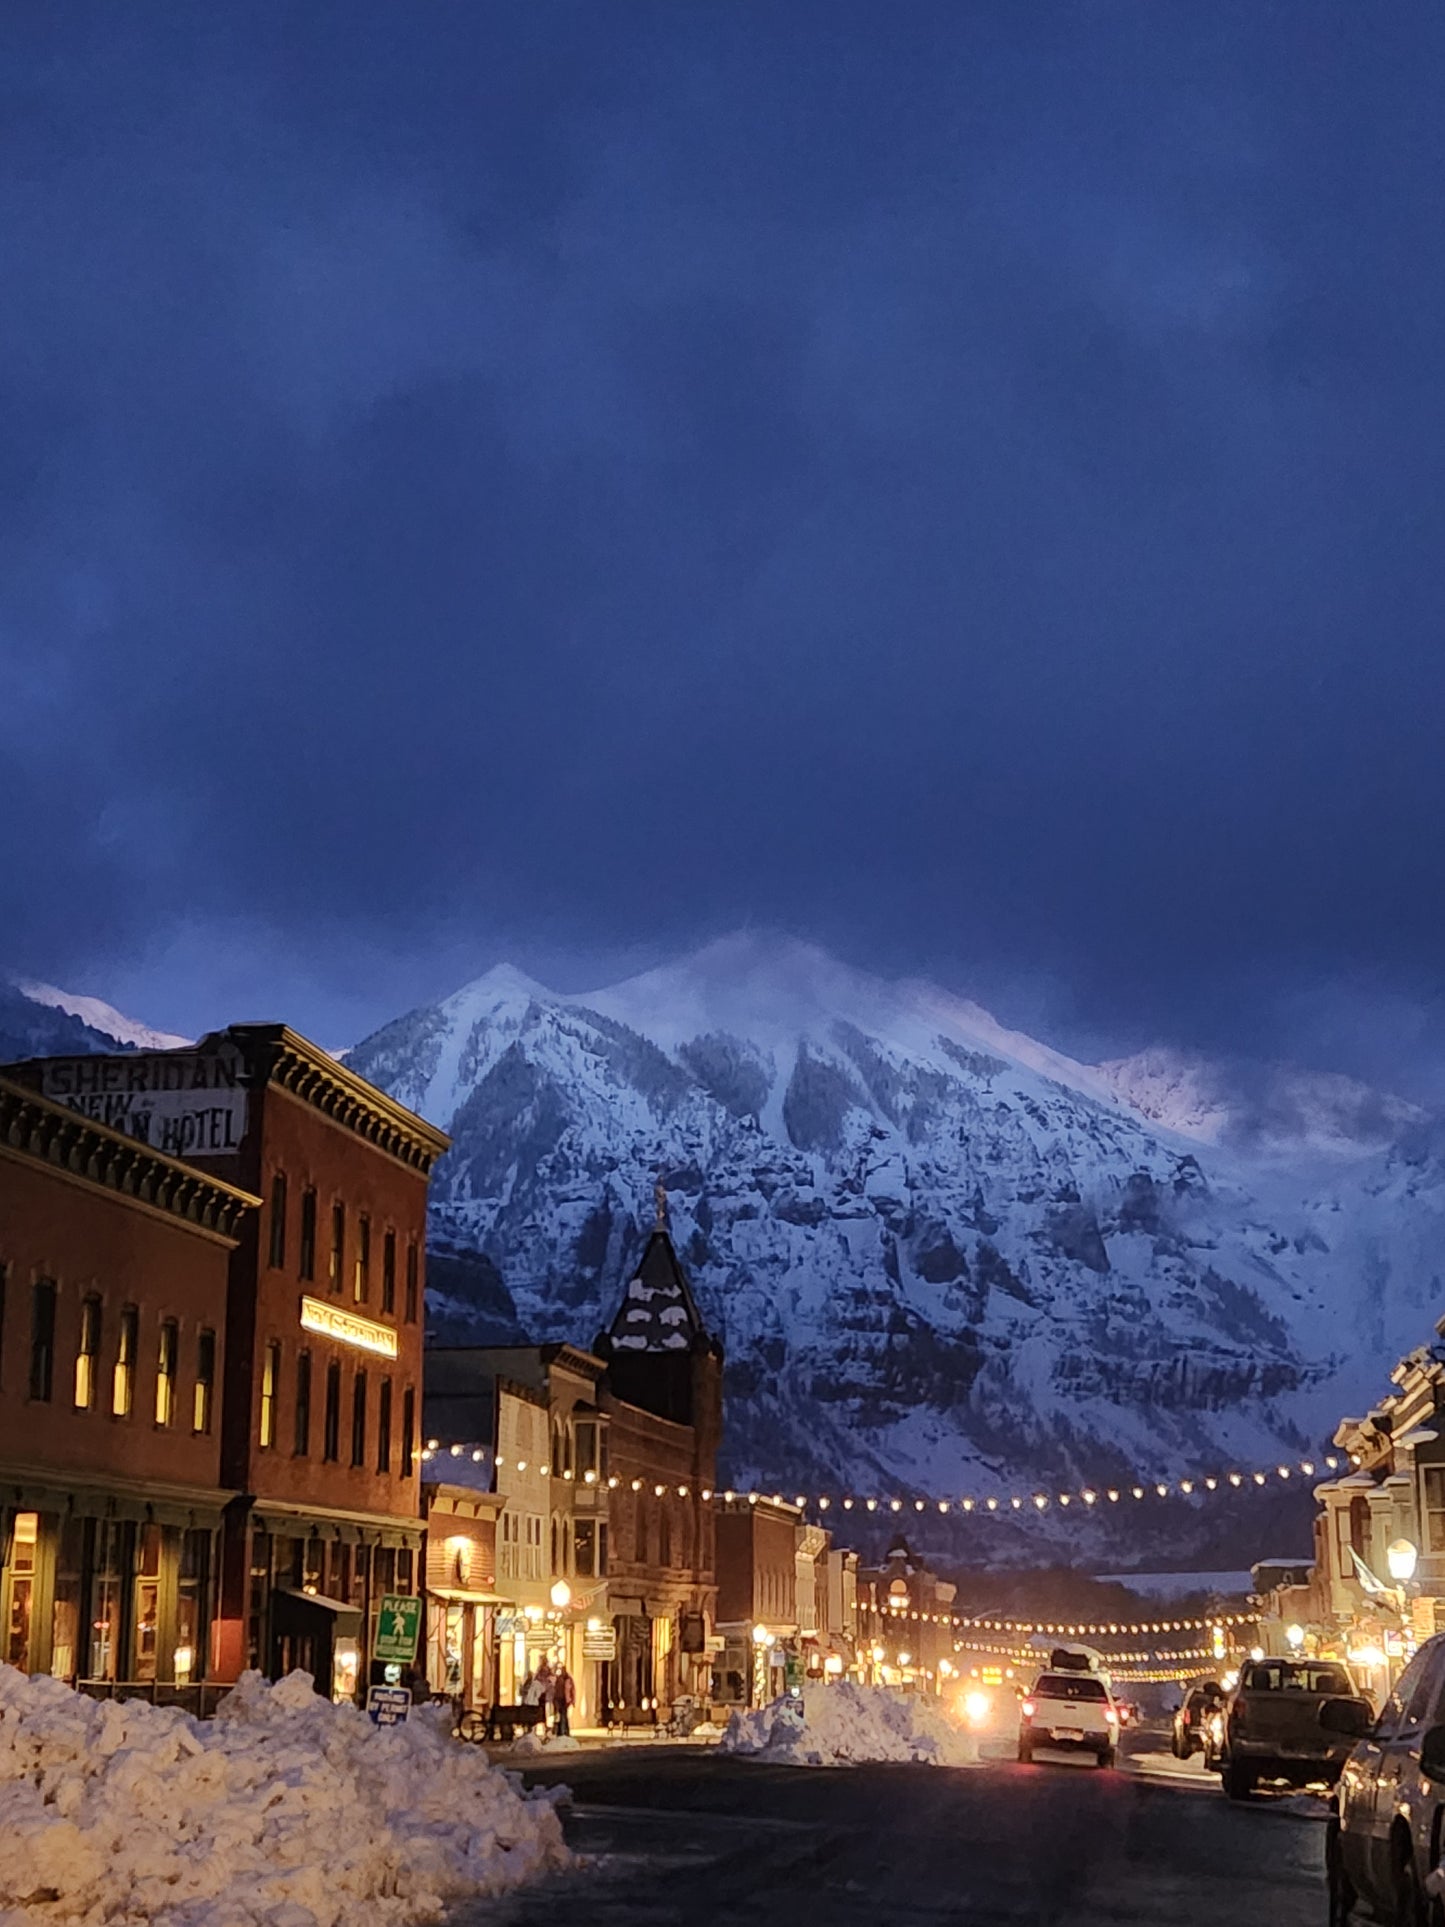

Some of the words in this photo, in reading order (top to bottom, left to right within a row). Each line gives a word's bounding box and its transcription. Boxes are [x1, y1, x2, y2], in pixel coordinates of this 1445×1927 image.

[49, 1057, 238, 1095] SHERIDAN
[67, 1094, 135, 1124] NEW
[162, 1108, 238, 1150] HOTEL
[383, 1599, 417, 1614] PLEASE
